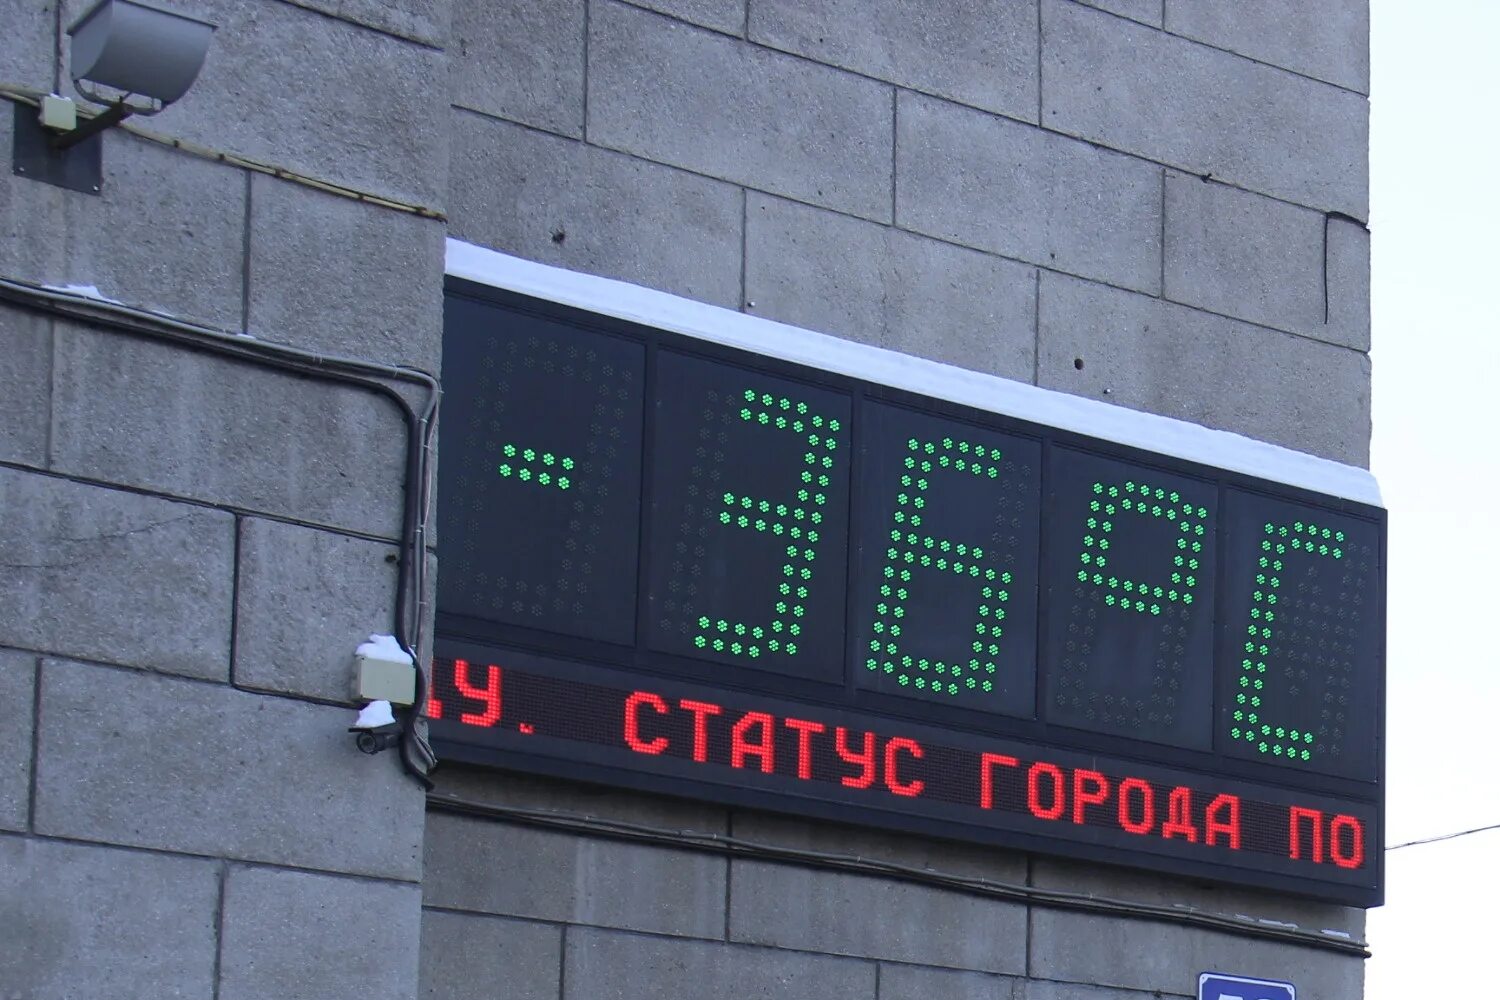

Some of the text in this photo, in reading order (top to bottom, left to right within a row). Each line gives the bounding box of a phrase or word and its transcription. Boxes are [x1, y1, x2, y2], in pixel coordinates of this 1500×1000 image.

[427, 659, 1363, 869] У. СТАТУС ГОРОДА ПО
